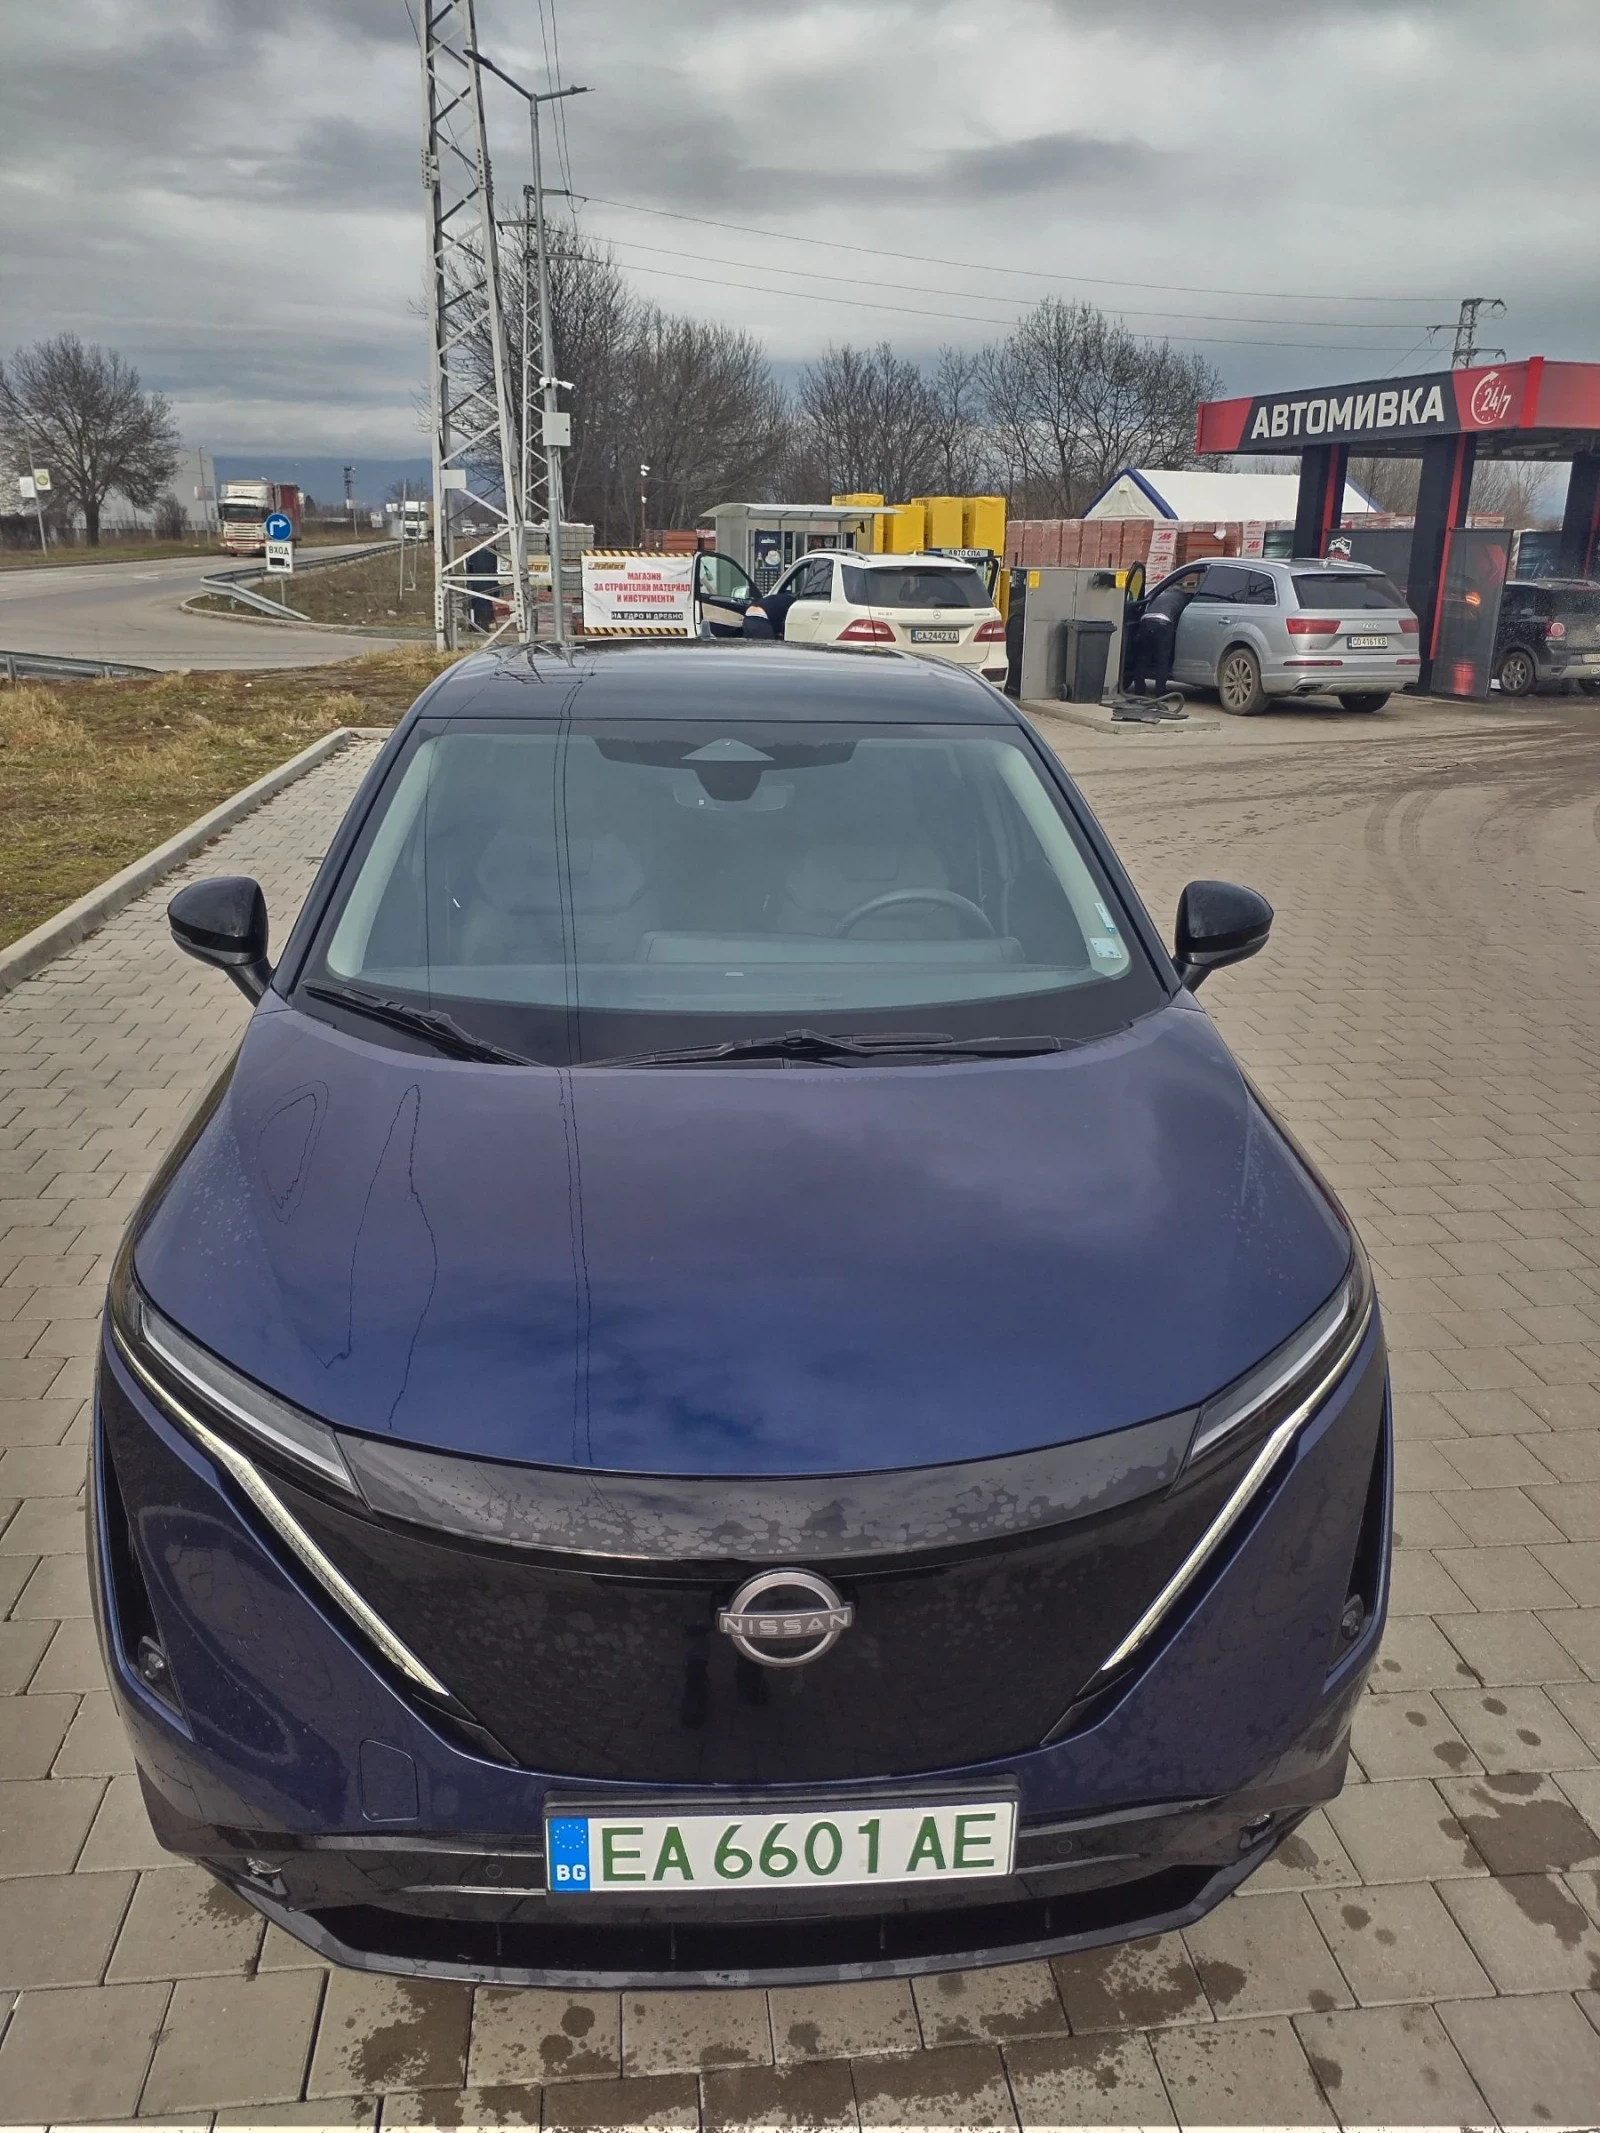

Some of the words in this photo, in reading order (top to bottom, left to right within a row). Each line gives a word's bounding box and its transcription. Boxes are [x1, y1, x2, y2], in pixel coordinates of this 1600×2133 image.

[1481, 385, 1512, 419] 24/7
[1251, 386, 1444, 439] АВТОМИВКА
[268, 546, 290, 555] ВХОД
[967, 549, 981, 557] СПА
[627, 572, 661, 581] МАГАЗИН
[594, 583, 604, 591] ЗА
[605, 583, 651, 592] СТРОИТЕЛНИ
[652, 583, 691, 592] МАТЕРИАЛ
[616, 595, 622, 603] И
[623, 595, 675, 603] ИНСТРУМЕНТИ
[624, 612, 644, 620] ЕДРО
[928, 632, 947, 641] 2442
[948, 632, 957, 641] XA
[1362, 638, 1376, 646] 4161
[721, 1611, 851, 1636] NISSAN
[601, 1826, 694, 1883] EA
[713, 1818, 882, 1880] 6601
[905, 1812, 997, 1873] AE
[556, 1863, 587, 1882] BG
